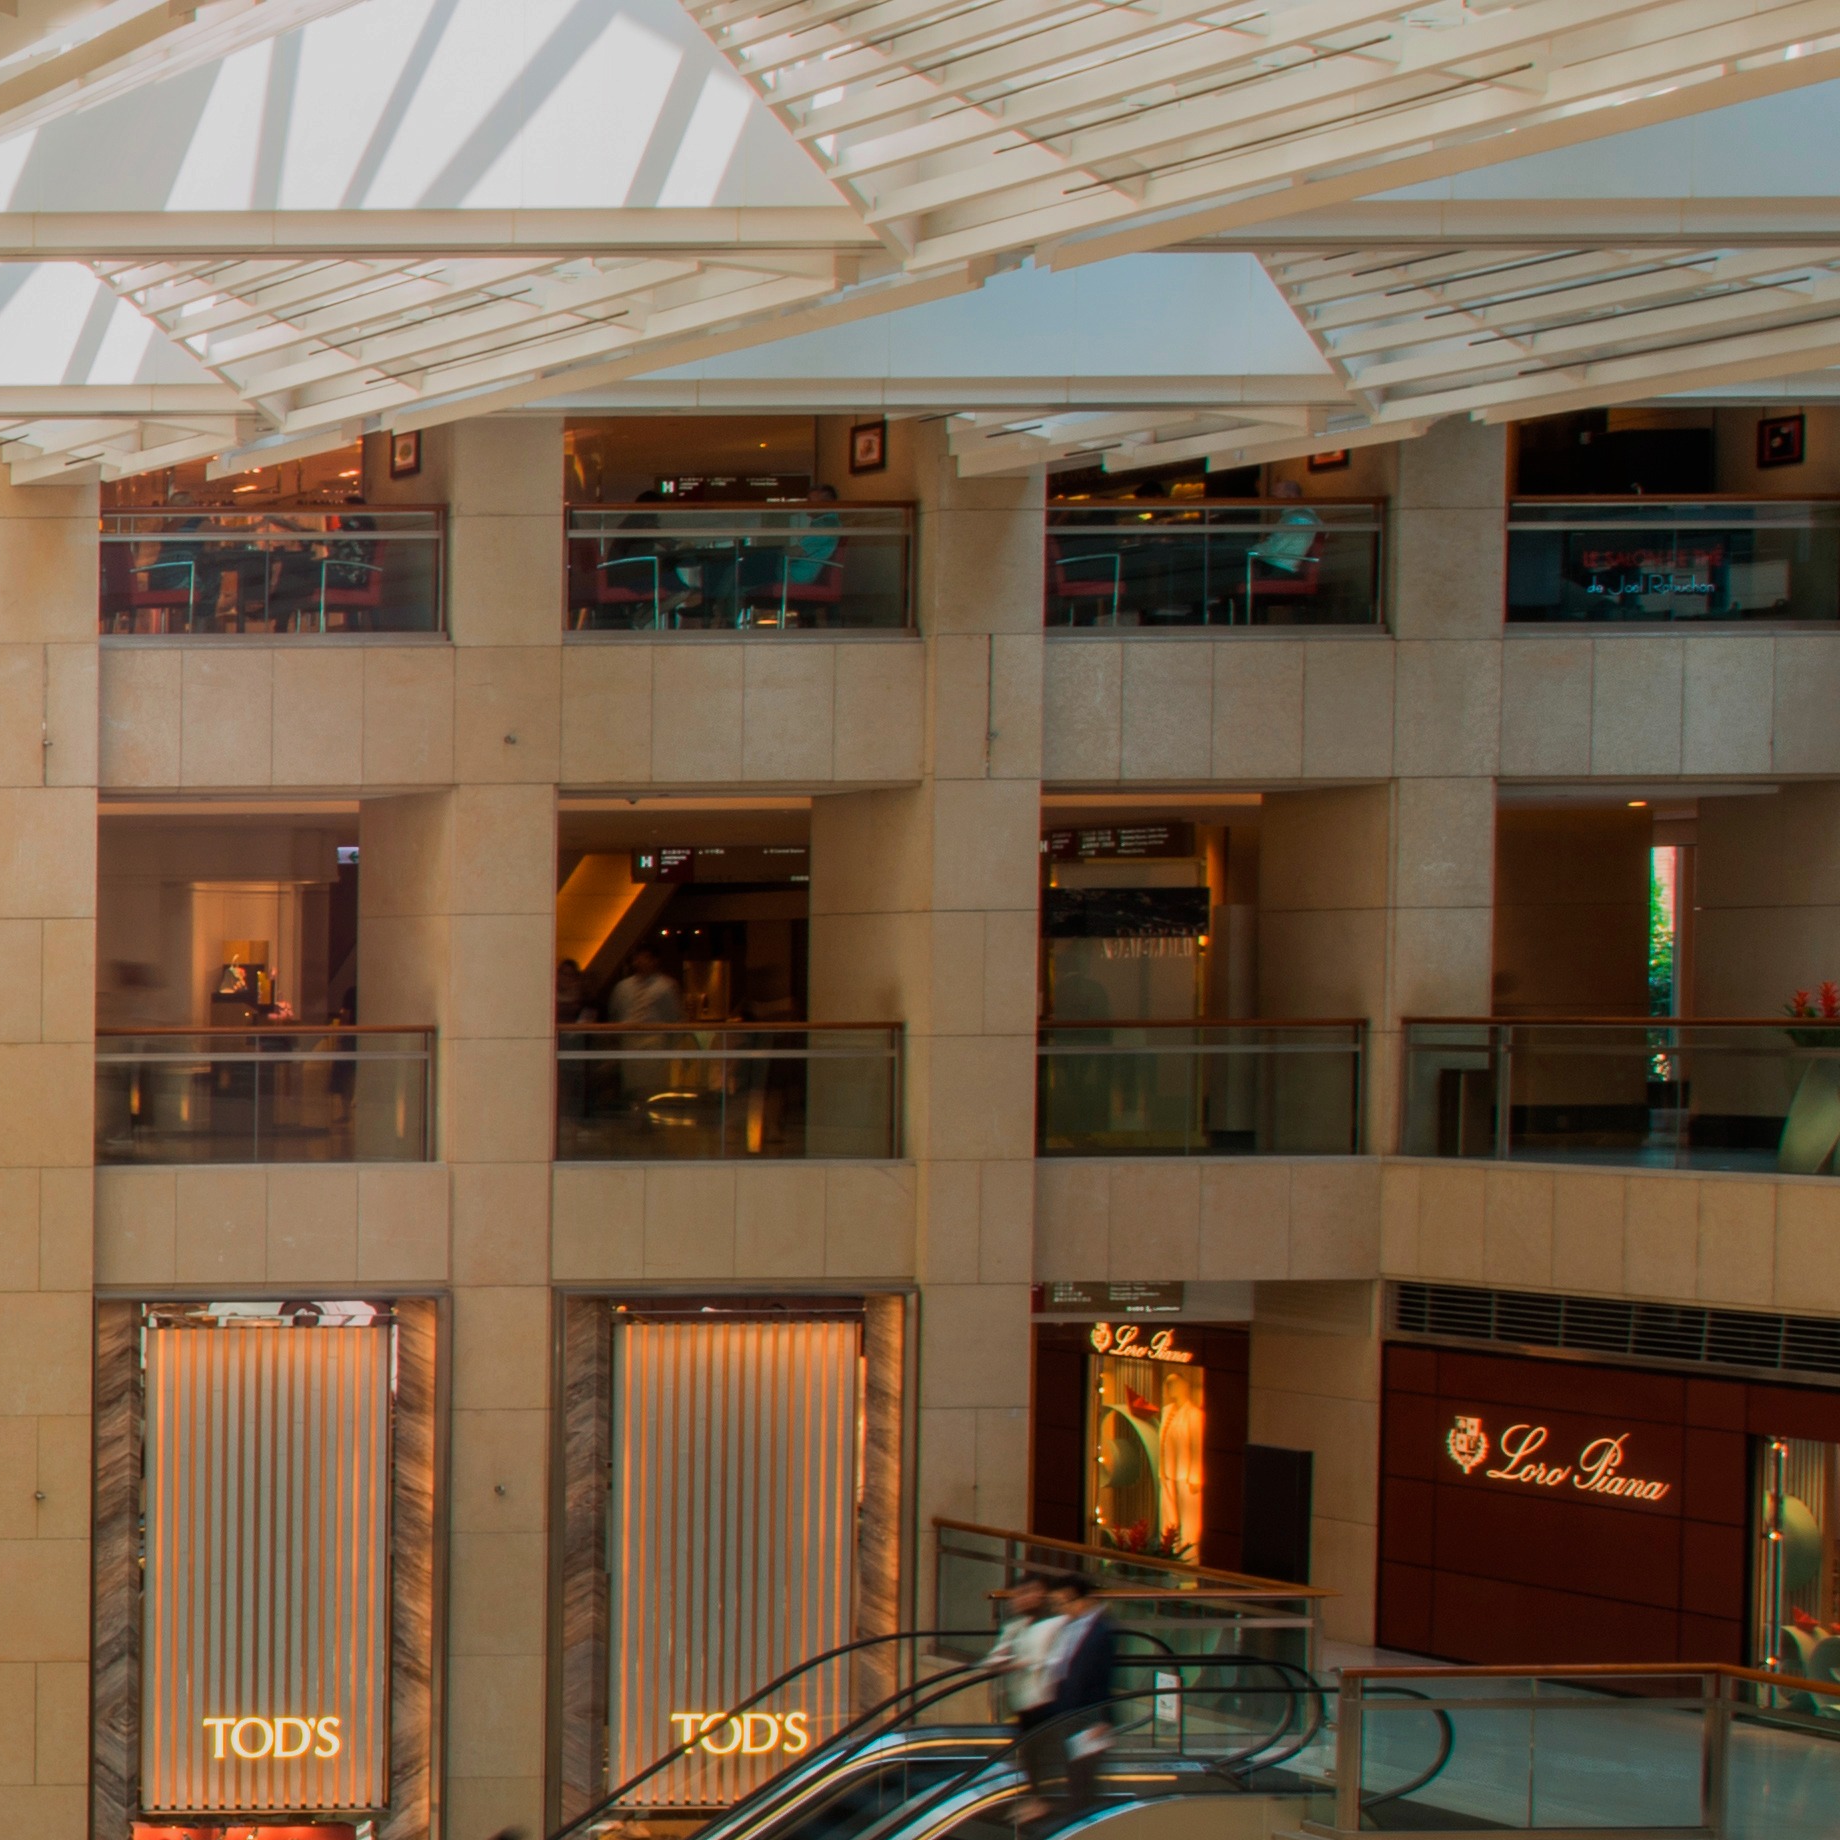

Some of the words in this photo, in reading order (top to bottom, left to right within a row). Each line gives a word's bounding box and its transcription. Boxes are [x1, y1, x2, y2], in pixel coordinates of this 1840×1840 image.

[1587, 575, 1604, 593] de
[1108, 1324, 1150, 1358] Loro
[1148, 1328, 1194, 1363] Piana
[1486, 1423, 1572, 1486] Loro
[1573, 1433, 1671, 1500] Piana
[203, 1716, 340, 1758] TOD'S
[671, 1711, 810, 1754] TOD'S
